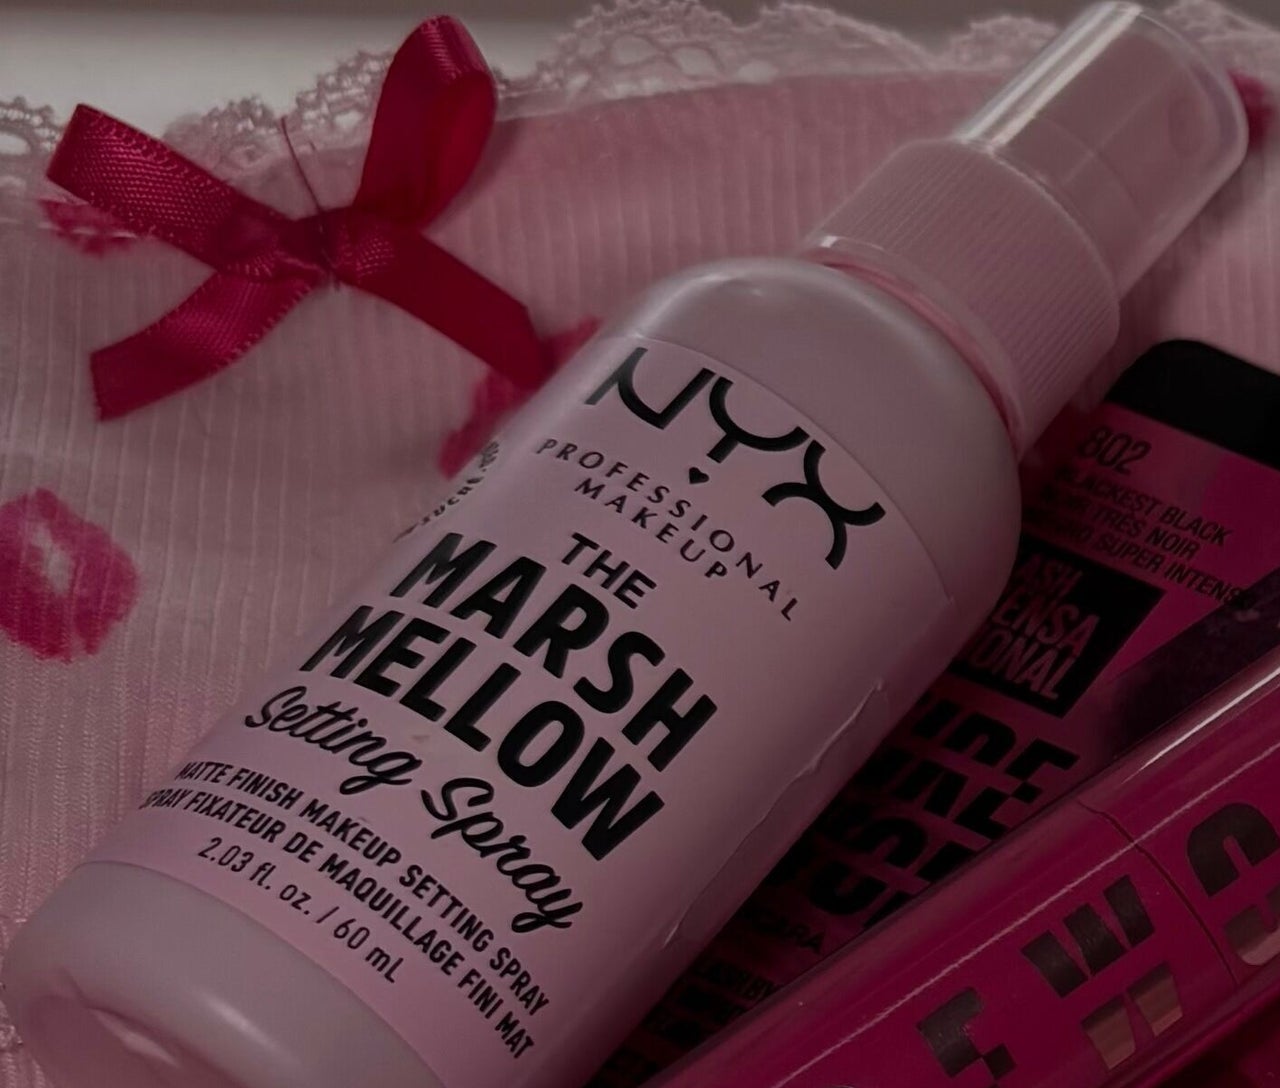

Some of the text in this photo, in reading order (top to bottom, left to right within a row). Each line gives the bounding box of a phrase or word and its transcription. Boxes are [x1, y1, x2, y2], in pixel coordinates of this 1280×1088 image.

[585, 347, 885, 569] NYX
[1082, 426, 1152, 476] 802
[538, 438, 795, 620] PROFESSIONAL
[560, 533, 656, 609] THE
[574, 479, 729, 580] MAKEUP
[1012, 552, 1084, 599] ASH
[1094, 532, 1166, 574] SUPER
[1146, 526, 1201, 560] NOIR
[1160, 506, 1233, 548] BLACK
[390, 532, 717, 772] MARSH
[991, 588, 1101, 649] ENSA
[299, 606, 665, 861] MELLOW
[245, 686, 583, 933] Setting Spray
[174, 761, 549, 1016] MATTE FINISH MAKEUP SETTING SPRAY
[184, 791, 286, 843] FIXATEUR
[282, 832, 323, 863] DE
[318, 853, 465, 976] MAQUILLAGE
[457, 968, 504, 1019] FINI
[495, 1011, 534, 1059] MAT
[198, 837, 404, 984] 2.03 fl. oz. / 60 mL
